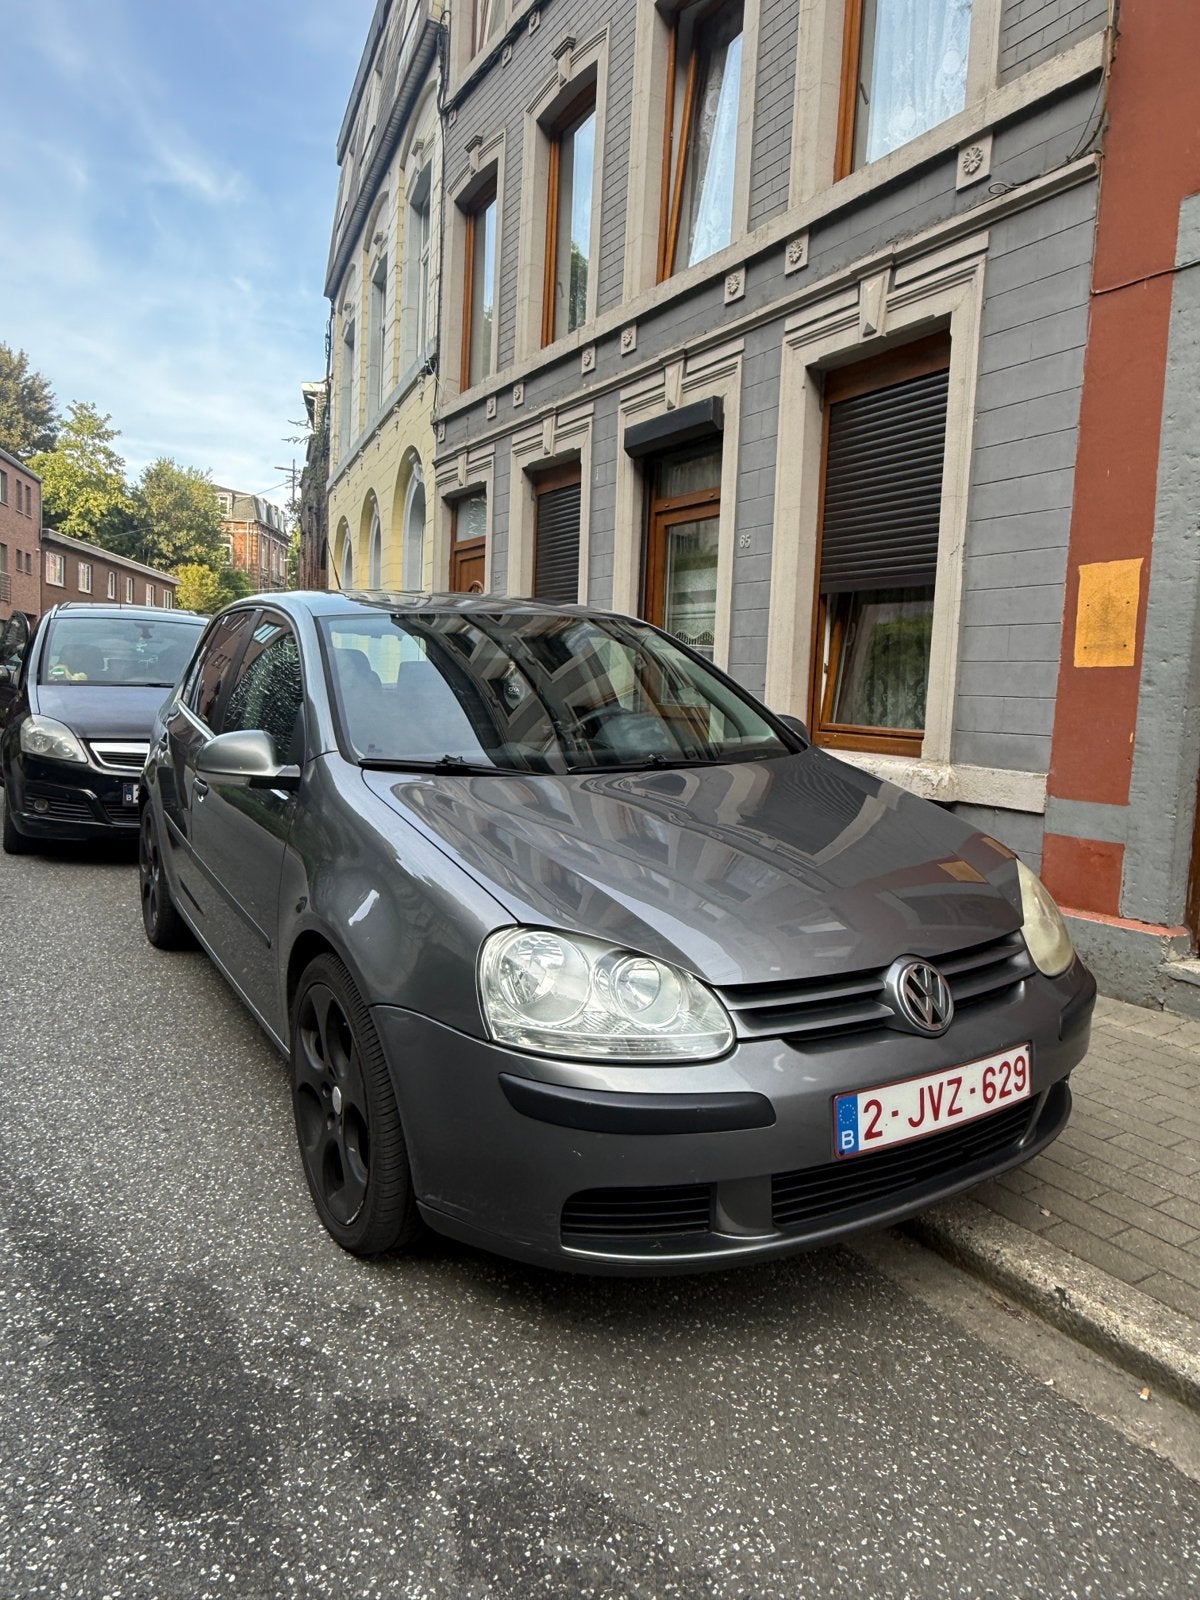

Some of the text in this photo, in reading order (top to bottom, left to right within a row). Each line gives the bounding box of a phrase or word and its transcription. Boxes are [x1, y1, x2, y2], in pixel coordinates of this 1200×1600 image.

[740, 534, 751, 548] 65
[863, 1055, 1027, 1141] 2-JVZ-629
[841, 1130, 855, 1150] B
